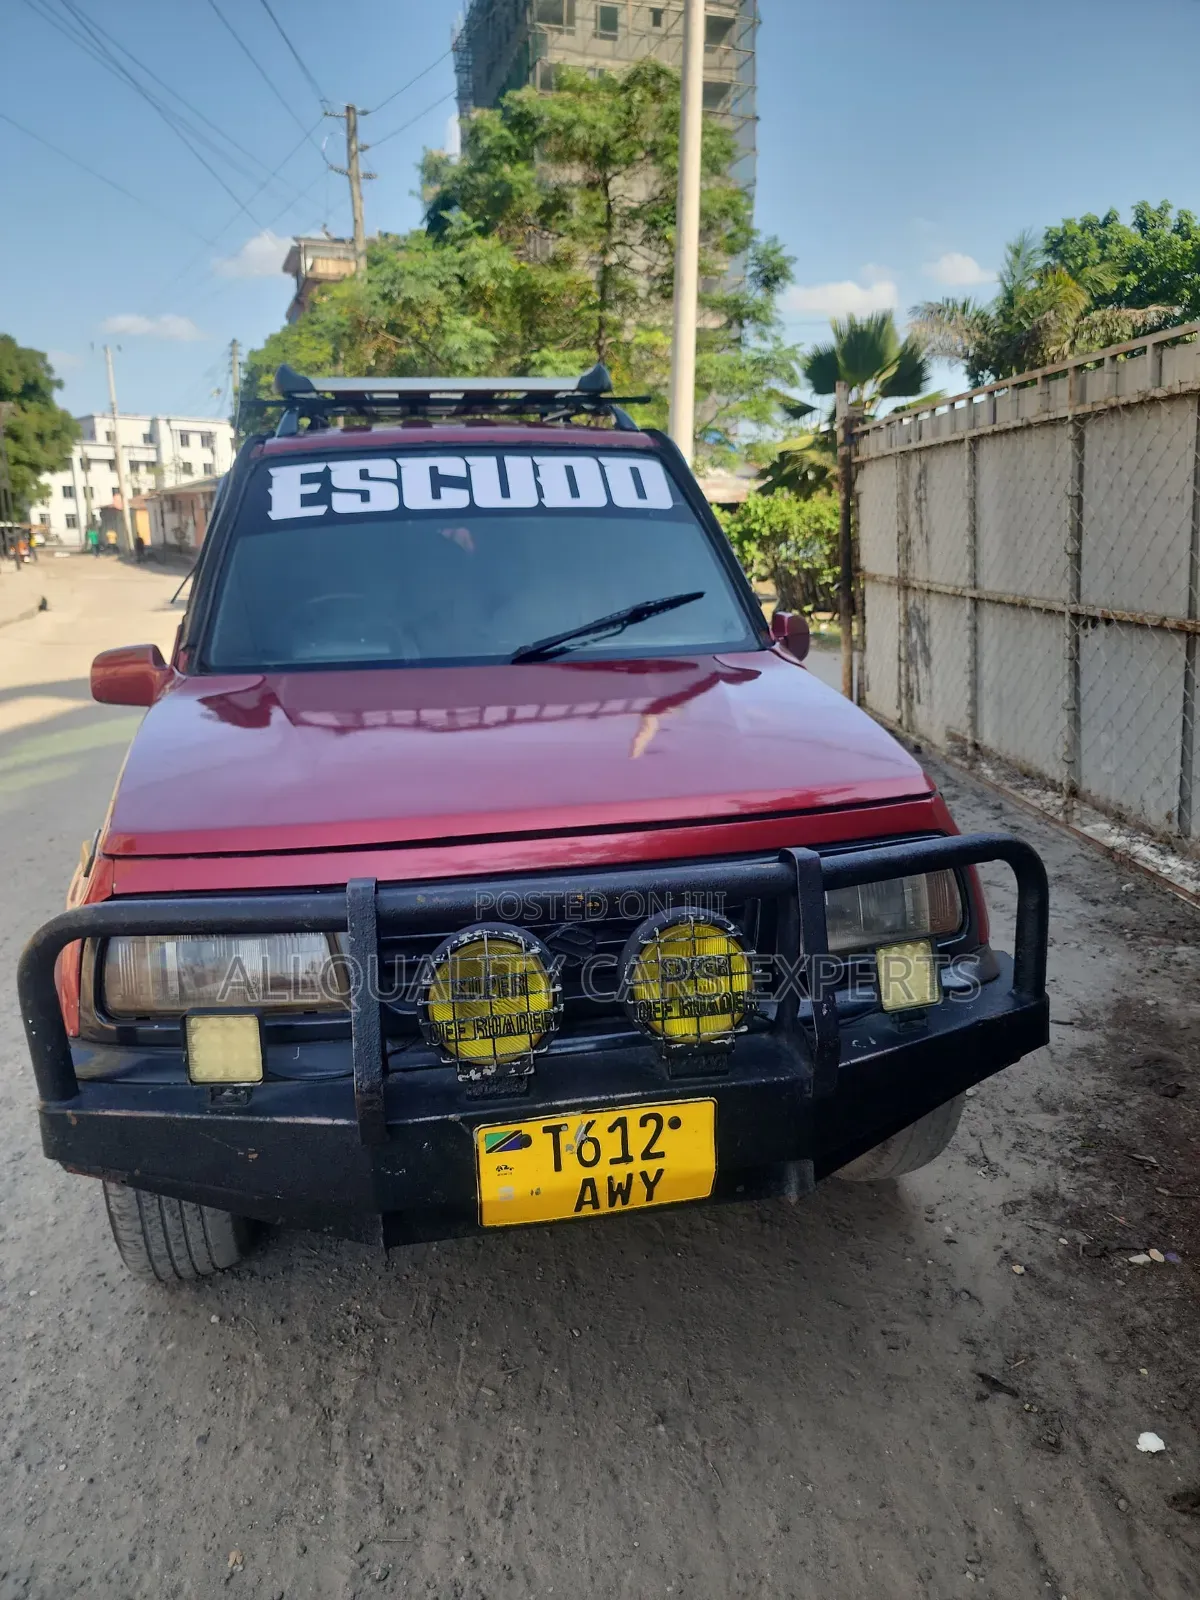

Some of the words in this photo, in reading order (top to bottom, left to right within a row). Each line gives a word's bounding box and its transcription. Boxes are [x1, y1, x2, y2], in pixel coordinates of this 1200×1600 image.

[267, 456, 674, 521] ESCUDO
[542, 1112, 665, 1172] T612
[574, 1168, 665, 1213] AWY
